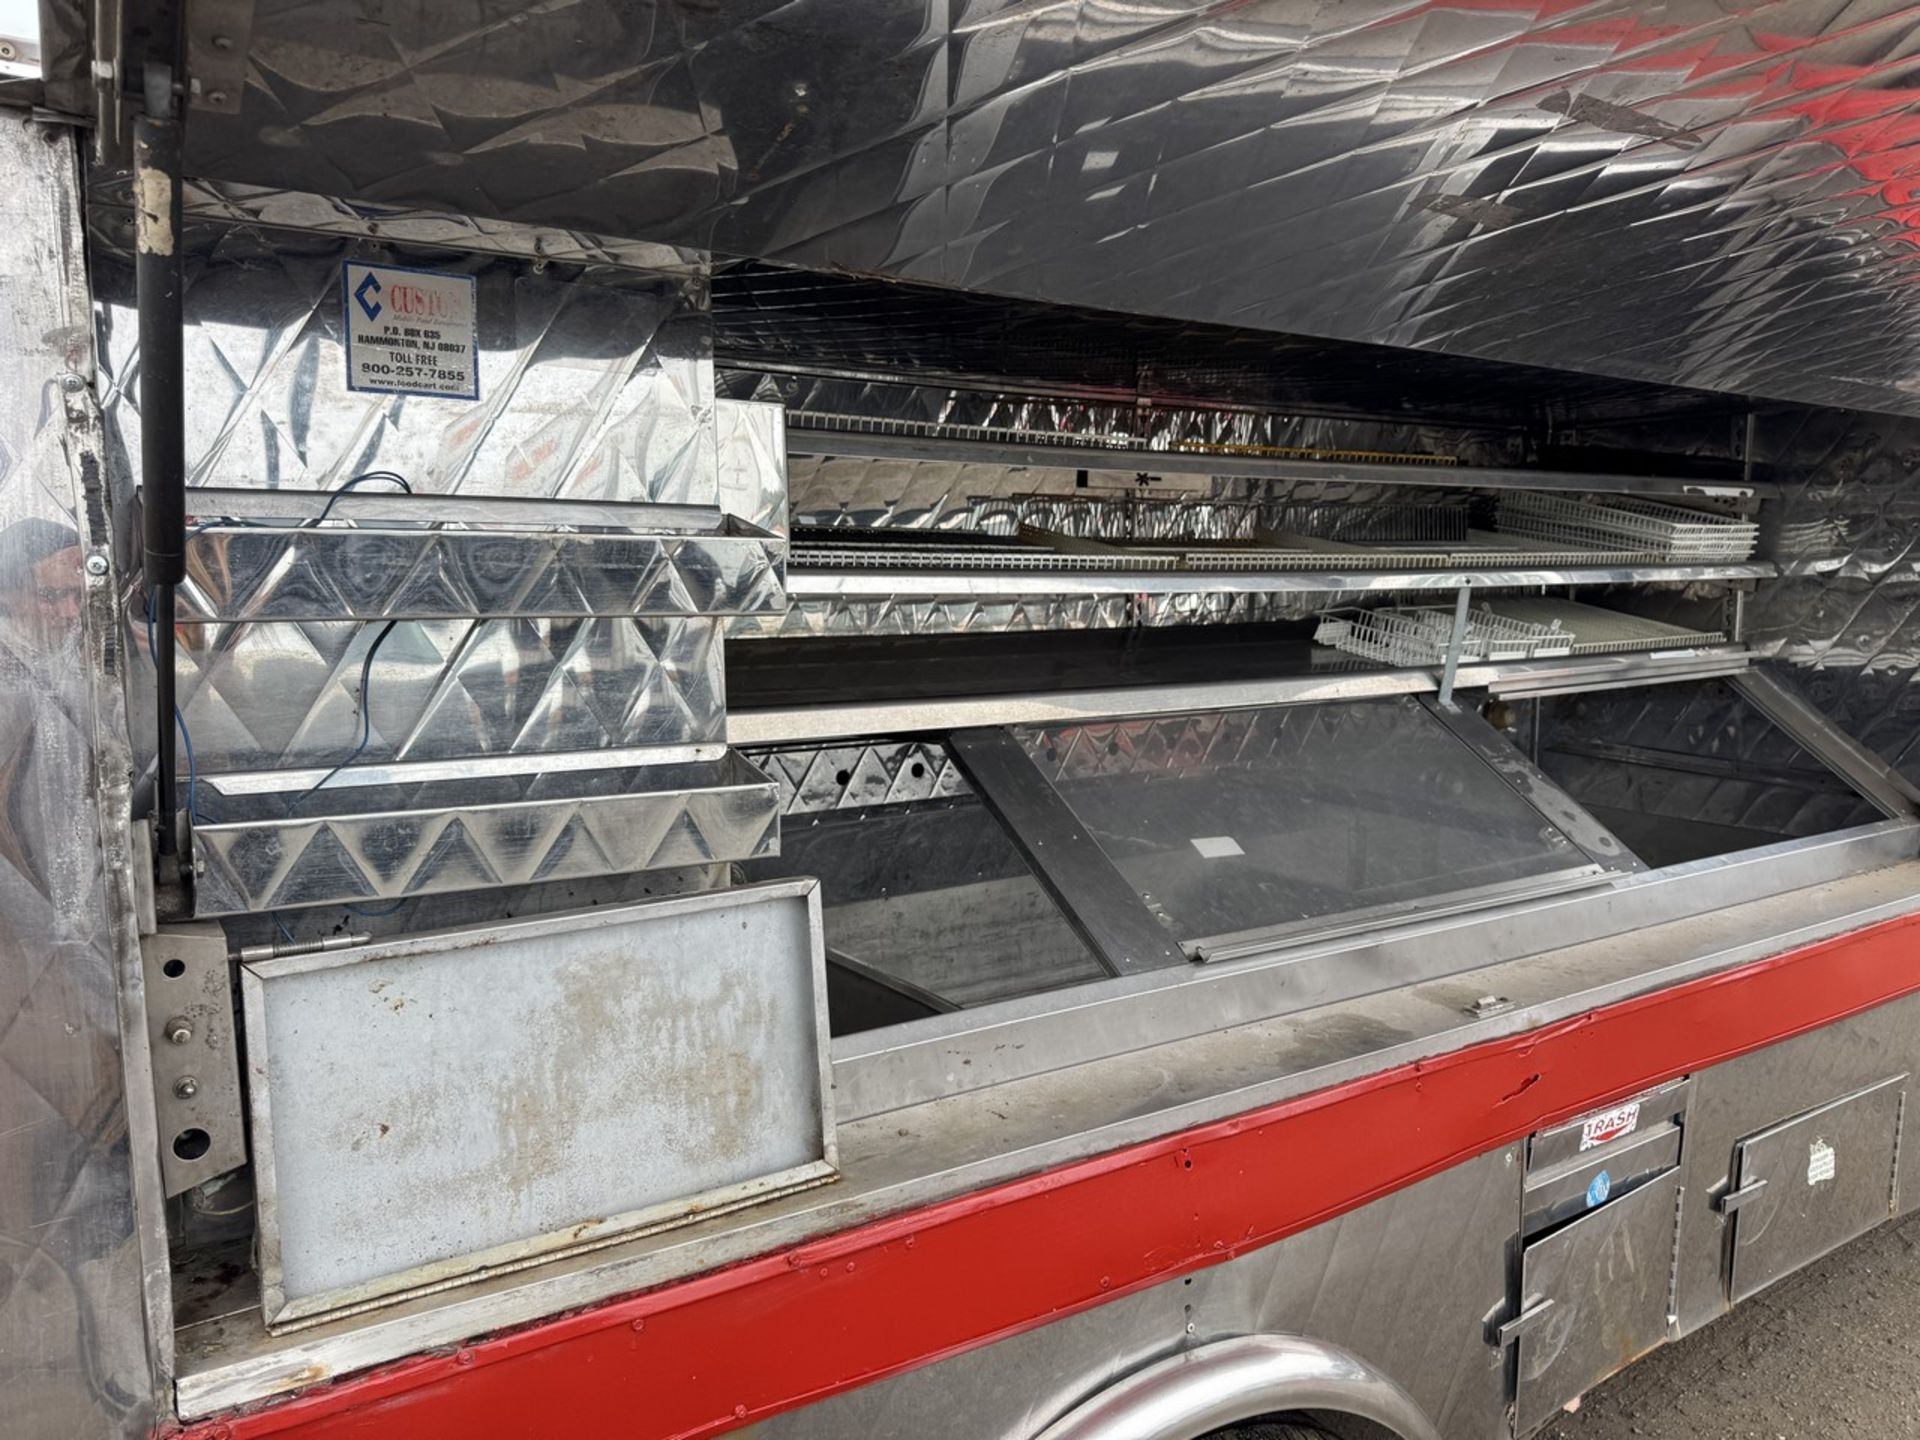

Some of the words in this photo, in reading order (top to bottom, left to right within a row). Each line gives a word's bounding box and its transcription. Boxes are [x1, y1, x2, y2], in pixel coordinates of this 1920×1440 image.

[391, 285, 462, 318] CUSTO
[384, 326, 401, 336] P.O.
[404, 328, 421, 338] BOX
[358, 335, 420, 350] HAMMONTON,
[423, 342, 435, 350] NJ
[438, 343, 466, 353] 08037
[389, 352, 413, 364] TOLL
[416, 355, 437, 366] FREE
[362, 363, 465, 381] 800-257-7855
[369, 378, 460, 391] www.foodcartcom
[1586, 1108, 1638, 1136] TRASH
